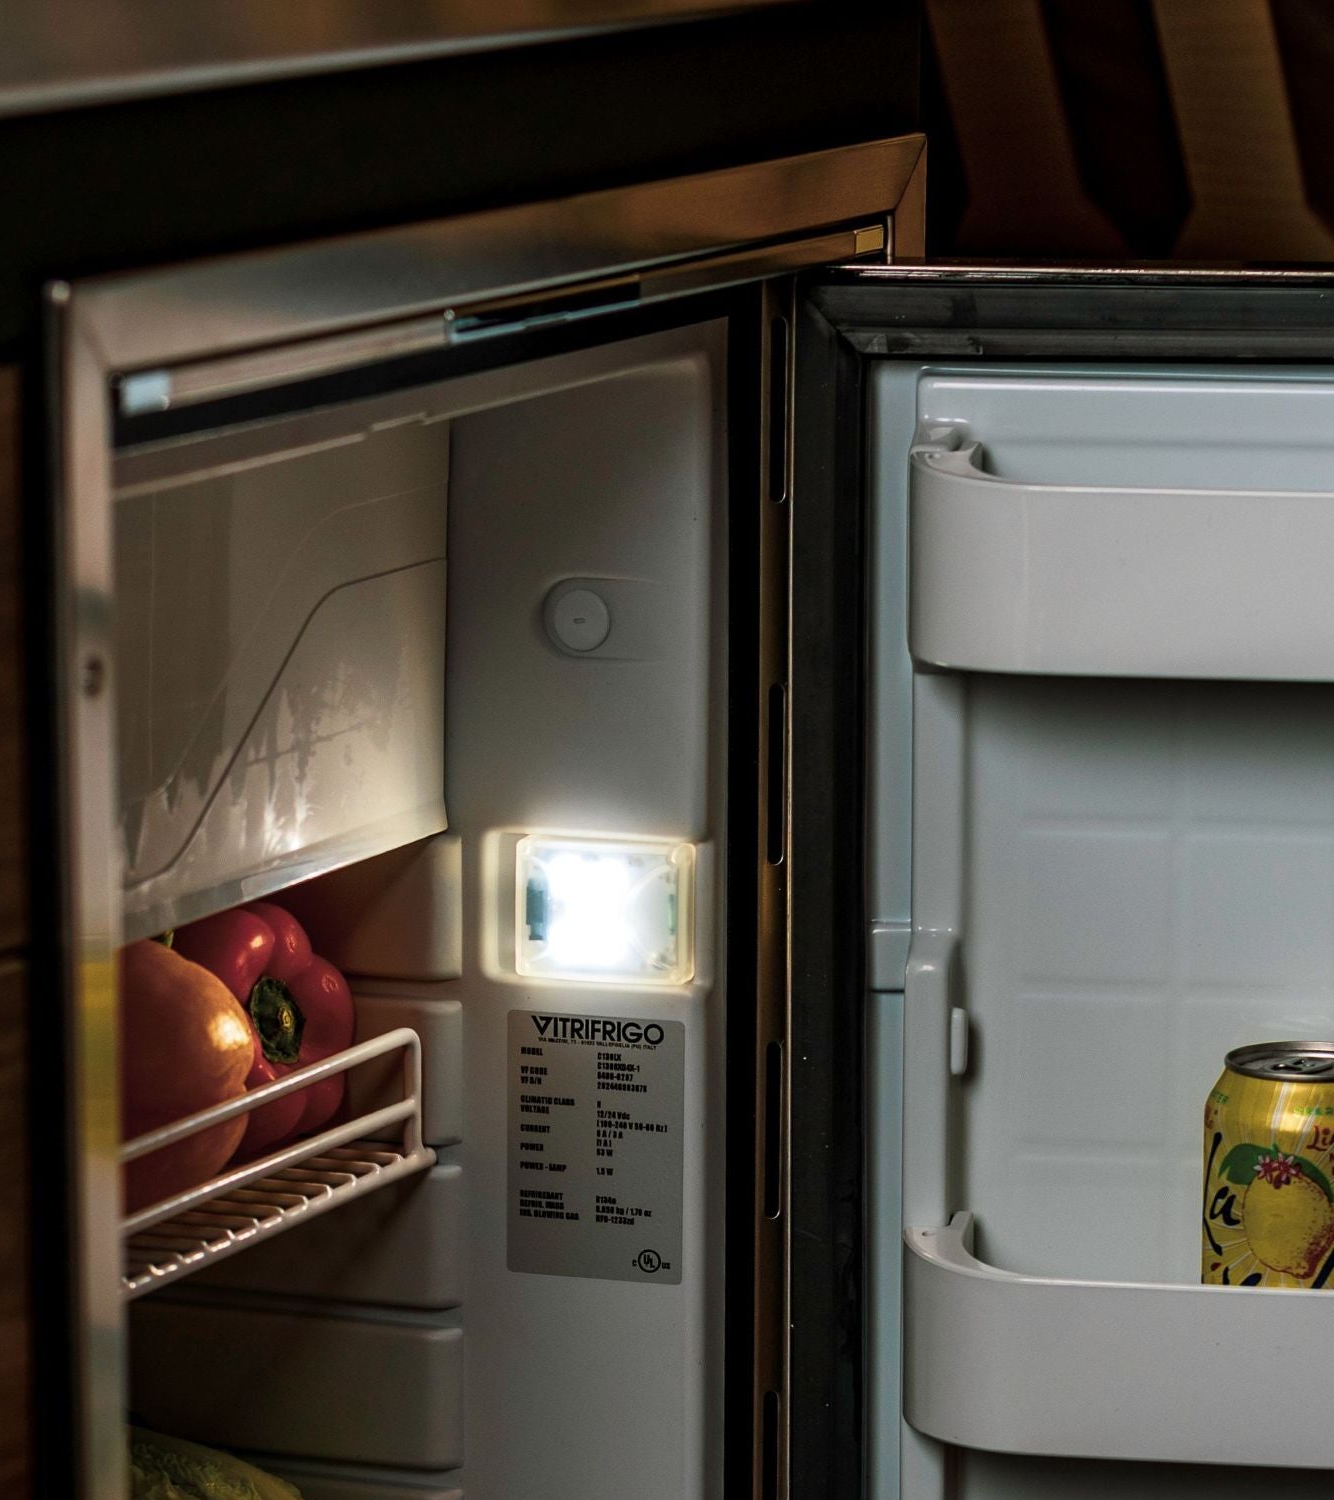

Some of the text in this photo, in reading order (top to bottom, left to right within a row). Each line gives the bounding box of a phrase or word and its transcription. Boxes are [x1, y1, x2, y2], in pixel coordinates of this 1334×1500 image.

[531, 1015, 664, 1045] VITRIFRIGO
[521, 1046, 543, 1056] MODEL
[530, 1066, 547, 1075] CODE
[520, 1094, 575, 1106] CLIMATIC CLASS
[520, 1104, 549, 1114] VOLTAGE
[520, 1123, 550, 1133] CURRENT
[520, 1142, 544, 1151] POWER
[606, 1149, 613, 1157] W
[520, 1161, 543, 1170] POWER
[606, 1168, 614, 1176] W
[520, 1189, 563, 1200] REFRIGERANT
